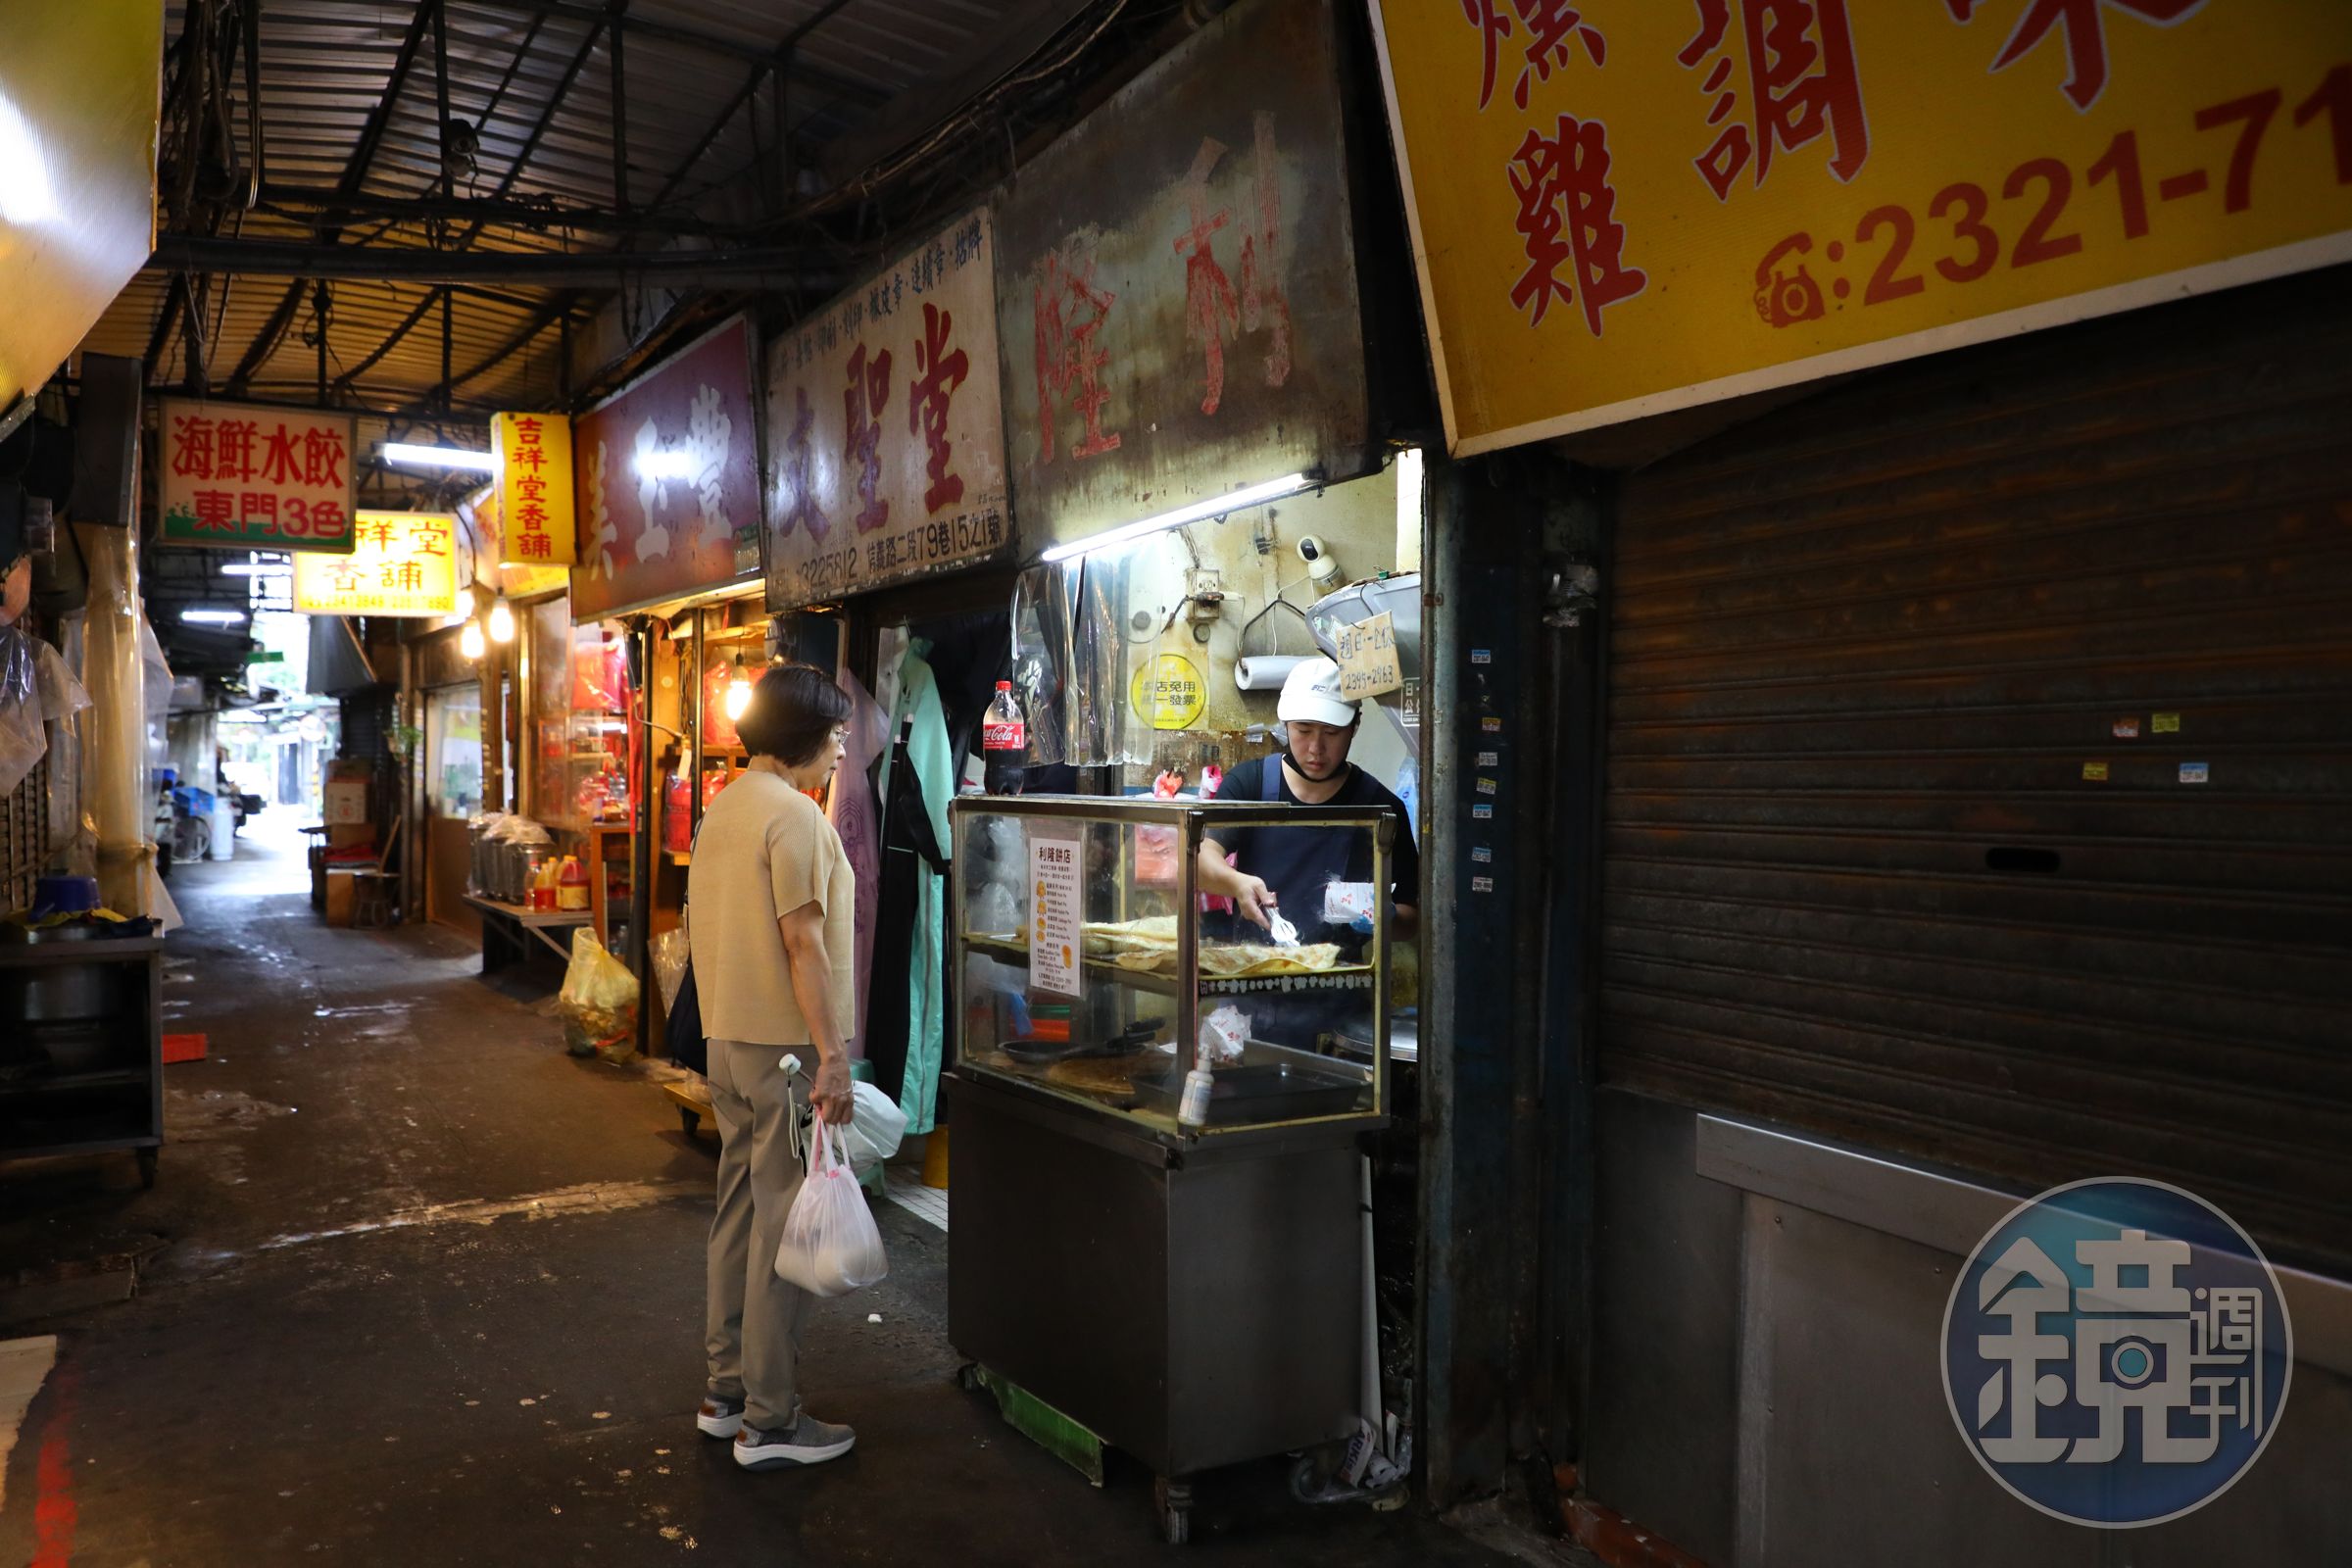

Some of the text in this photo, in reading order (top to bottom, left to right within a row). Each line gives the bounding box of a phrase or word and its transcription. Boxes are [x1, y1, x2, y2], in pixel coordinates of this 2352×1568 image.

[172, 415, 346, 489] 海鮮水餃
[192, 489, 345, 538] 東門3色
[355, 520, 448, 557] 祥堂
[1039, 847, 1071, 863] 利隆餅店
